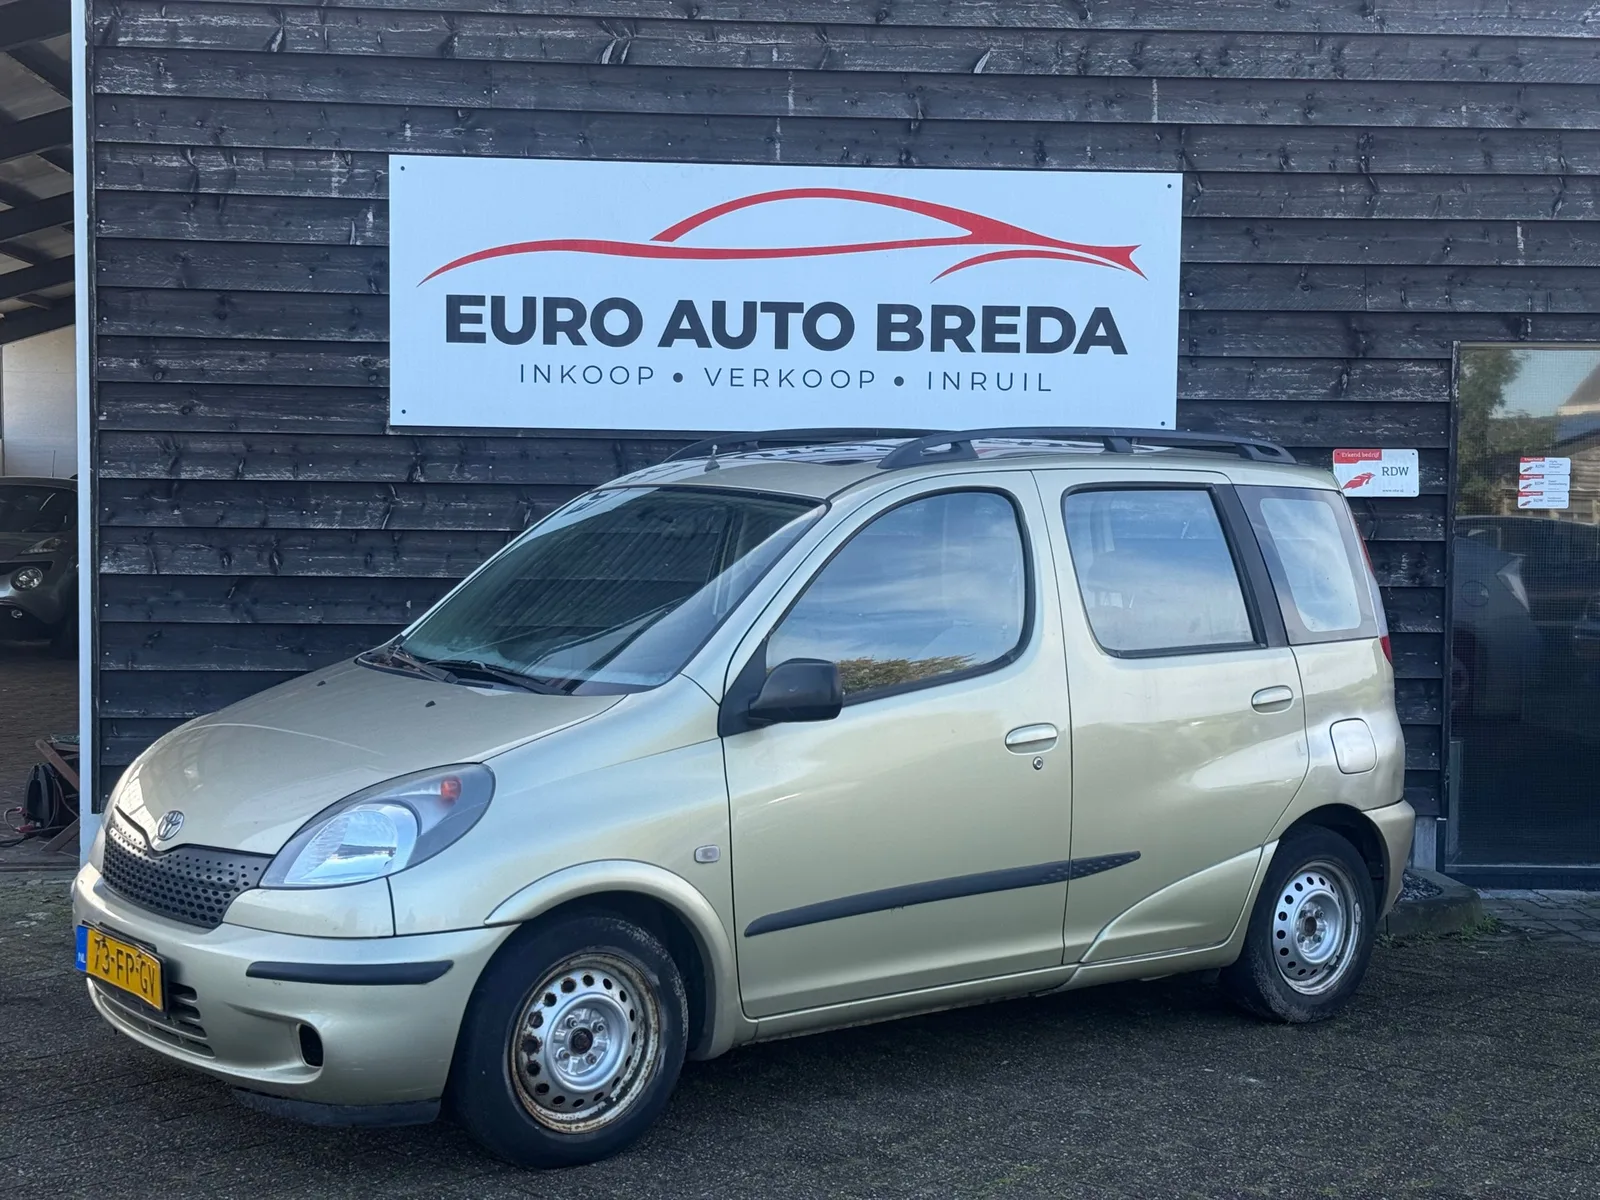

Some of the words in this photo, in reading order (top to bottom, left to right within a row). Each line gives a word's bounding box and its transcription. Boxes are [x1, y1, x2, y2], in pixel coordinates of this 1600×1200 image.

[445, 293, 644, 348] EURO
[656, 299, 856, 352] AUTO
[876, 303, 1129, 356] BREDA
[520, 363, 654, 386] INKOOP
[703, 367, 875, 389] VERKOOP
[928, 371, 1052, 392] INRUIL
[1381, 466, 1409, 477] RDW
[77, 951, 87, 963] NL
